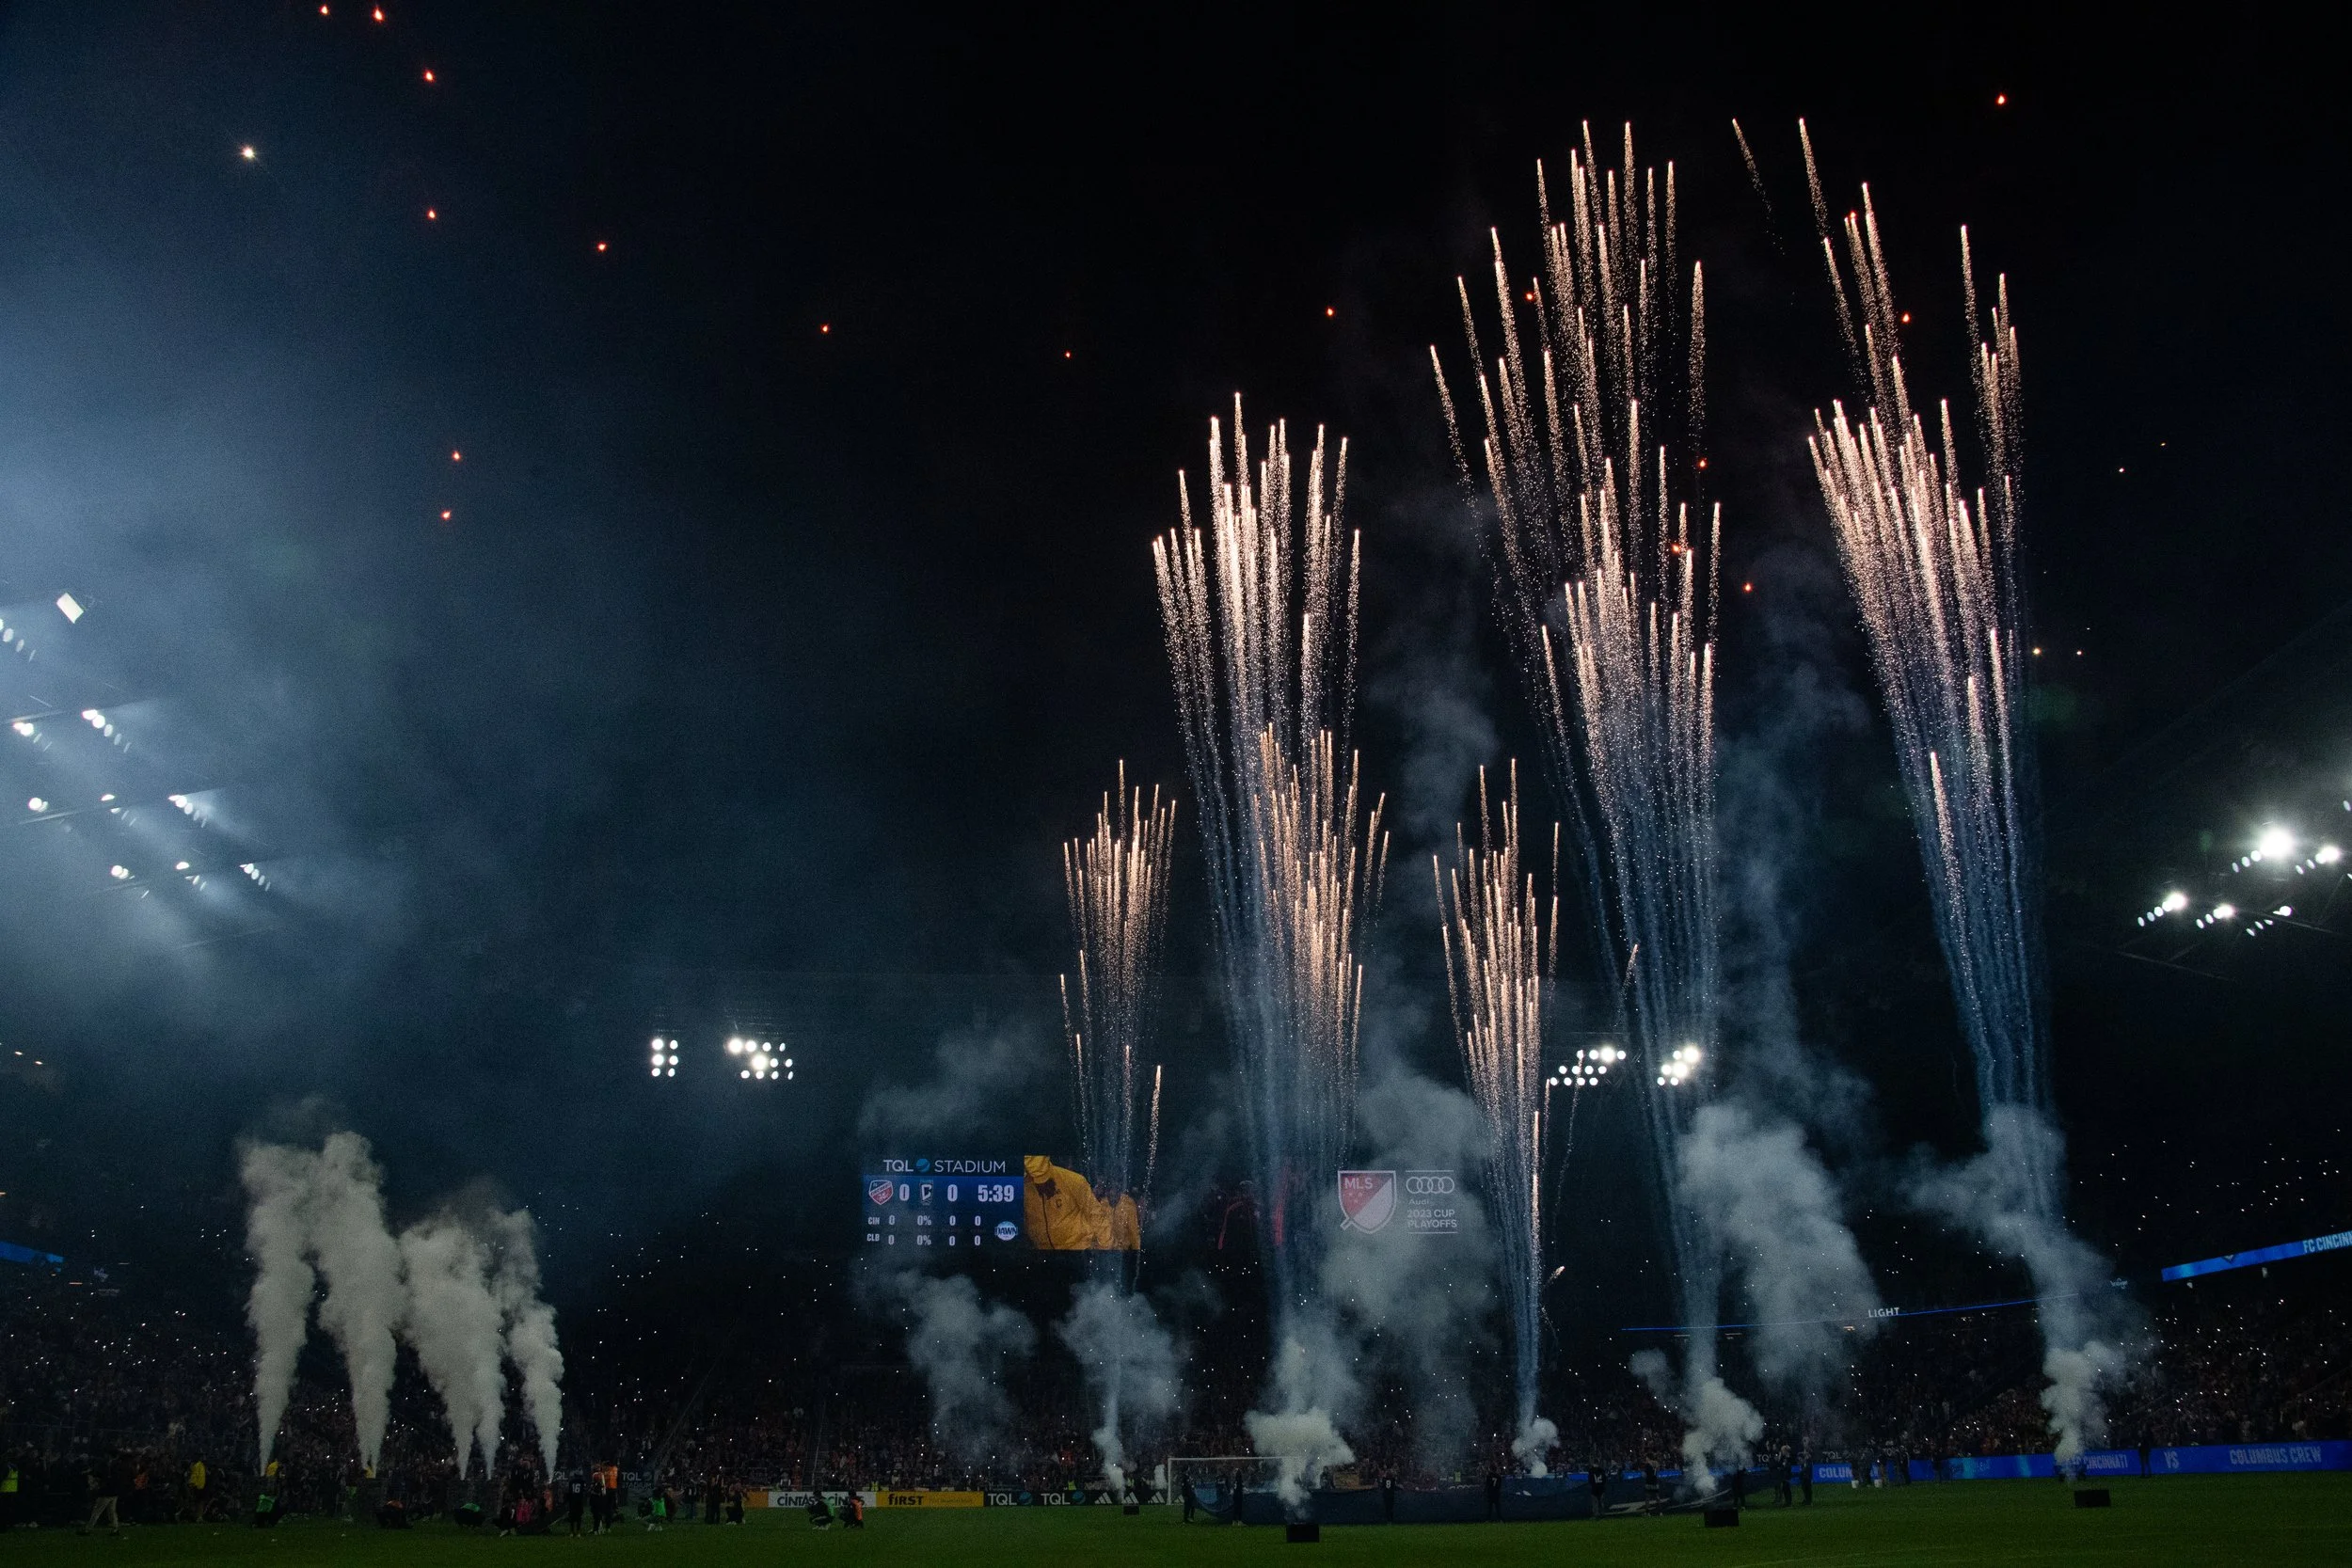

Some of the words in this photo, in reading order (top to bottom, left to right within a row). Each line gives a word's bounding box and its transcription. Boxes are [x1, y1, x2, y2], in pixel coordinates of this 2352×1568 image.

[882, 1159, 914, 1172] TQL
[934, 1160, 1006, 1173] STADIUM
[1344, 1178, 1374, 1189] MLS
[898, 1183, 910, 1201] 0
[946, 1183, 958, 1202] 0
[977, 1184, 1014, 1202] 5:39
[1407, 1209, 1431, 1218] 2023
[1434, 1209, 1455, 1218] CUP
[888, 1214, 895, 1226] 0
[917, 1215, 931, 1227] 0%
[949, 1215, 956, 1227] 0
[975, 1215, 981, 1227] 0
[1407, 1219, 1457, 1228] PLAYOFFS
[888, 1234, 895, 1245] 0
[916, 1234, 931, 1245] 0%
[949, 1235, 956, 1246] 0
[974, 1235, 980, 1246] 0
[2302, 1238, 2315, 1253] FC
[1867, 1307, 1899, 1318] LIGHT
[2163, 1449, 2180, 1469] VS
[2229, 1447, 2288, 1465] COLUMBUS
[2289, 1446, 2322, 1464] CREW
[988, 1493, 1017, 1506] TQL
[1041, 1493, 1071, 1506] TQL
